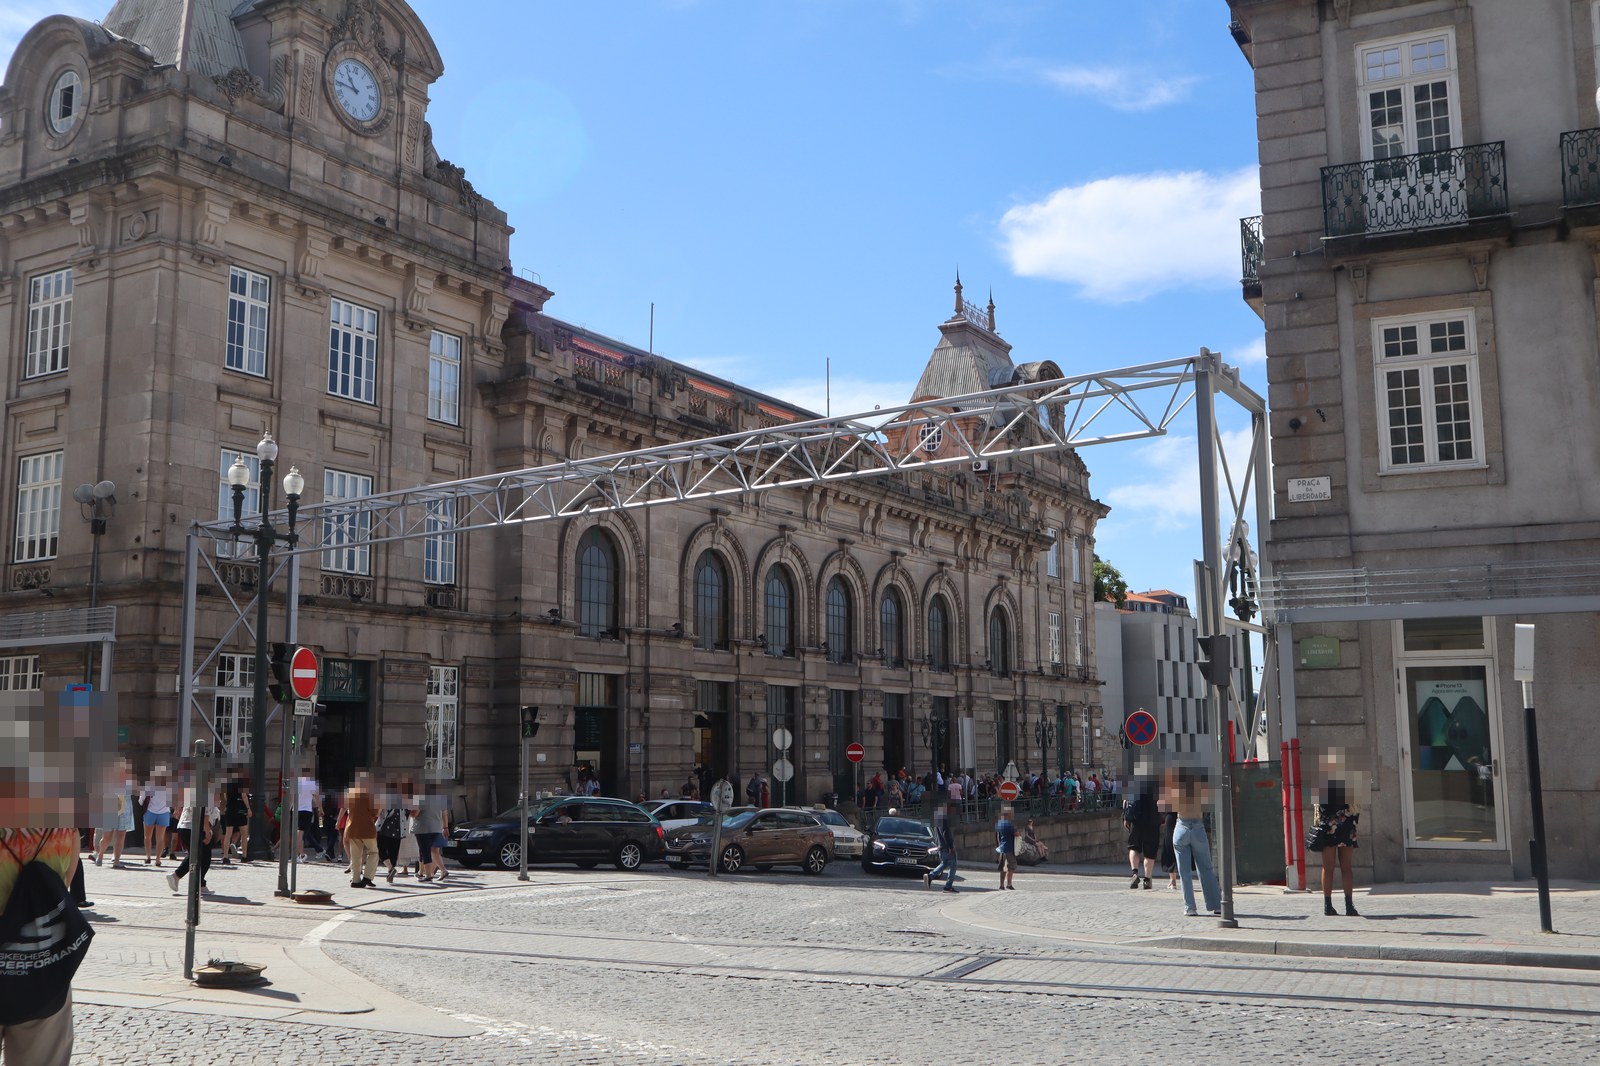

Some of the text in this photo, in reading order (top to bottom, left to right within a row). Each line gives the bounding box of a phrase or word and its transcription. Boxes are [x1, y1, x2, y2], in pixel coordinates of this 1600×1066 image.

[1297, 479, 1320, 487] PRAÇA
[1292, 492, 1328, 500] LIBERDADE
[0, 931, 89, 969] PERFORMANCE
[0, 950, 50, 960] SKECHERS
